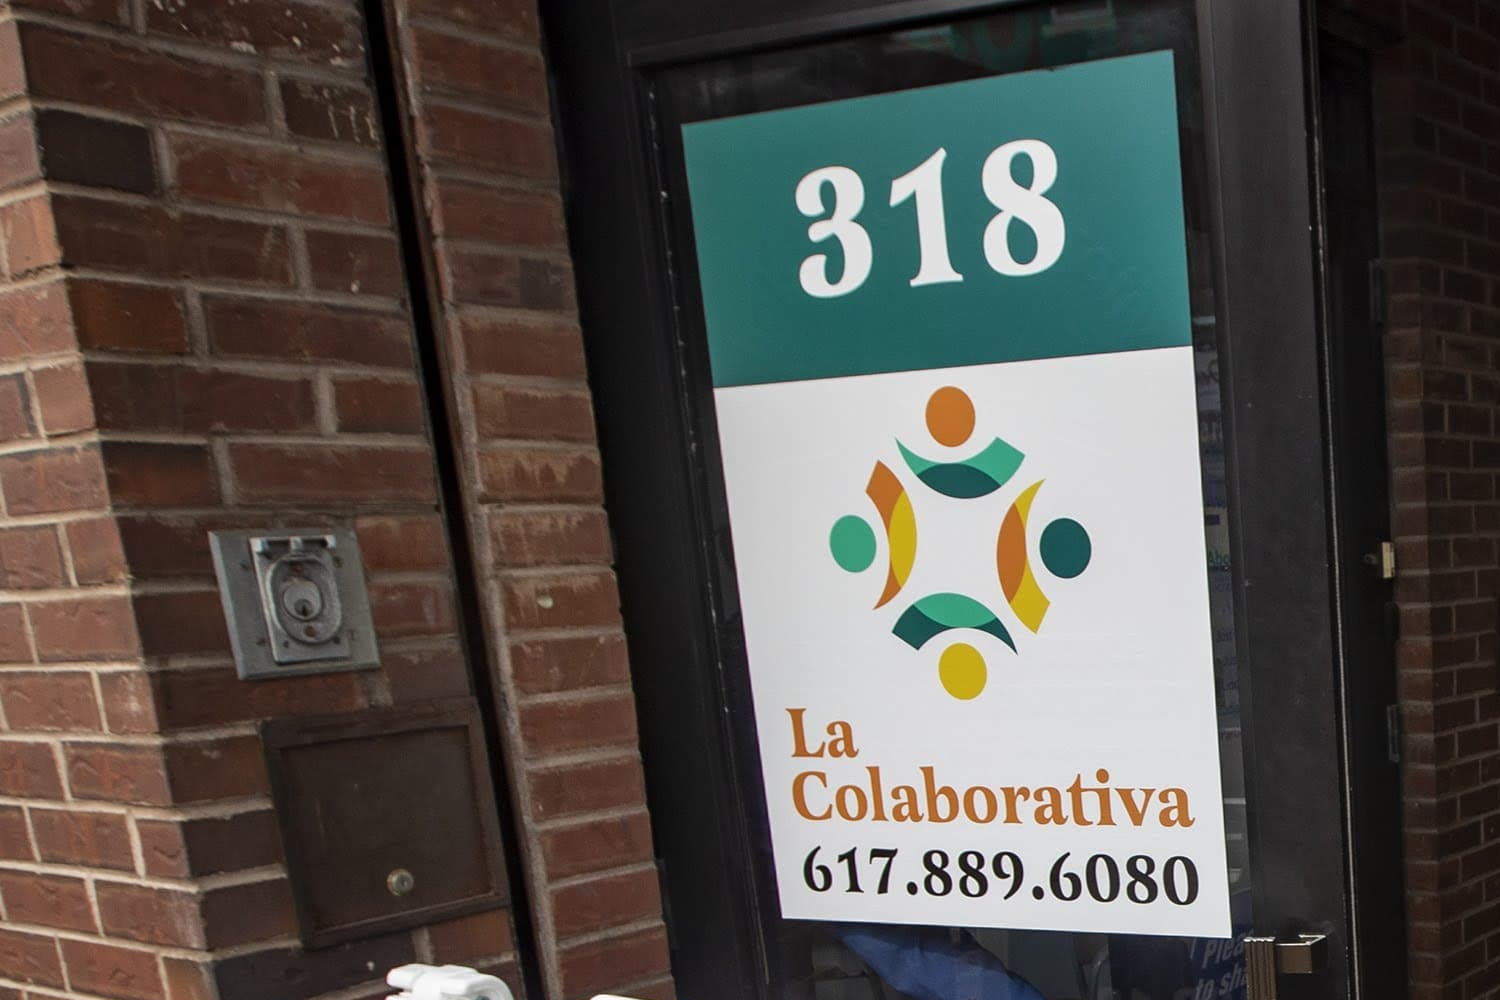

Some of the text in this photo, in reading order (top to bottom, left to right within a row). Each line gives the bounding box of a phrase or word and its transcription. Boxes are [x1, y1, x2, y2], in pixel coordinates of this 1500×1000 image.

[795, 139, 1066, 298] 318
[787, 708, 859, 760] La
[792, 766, 1196, 828] Colaborativa
[803, 845, 1200, 906] 617.889.6080
